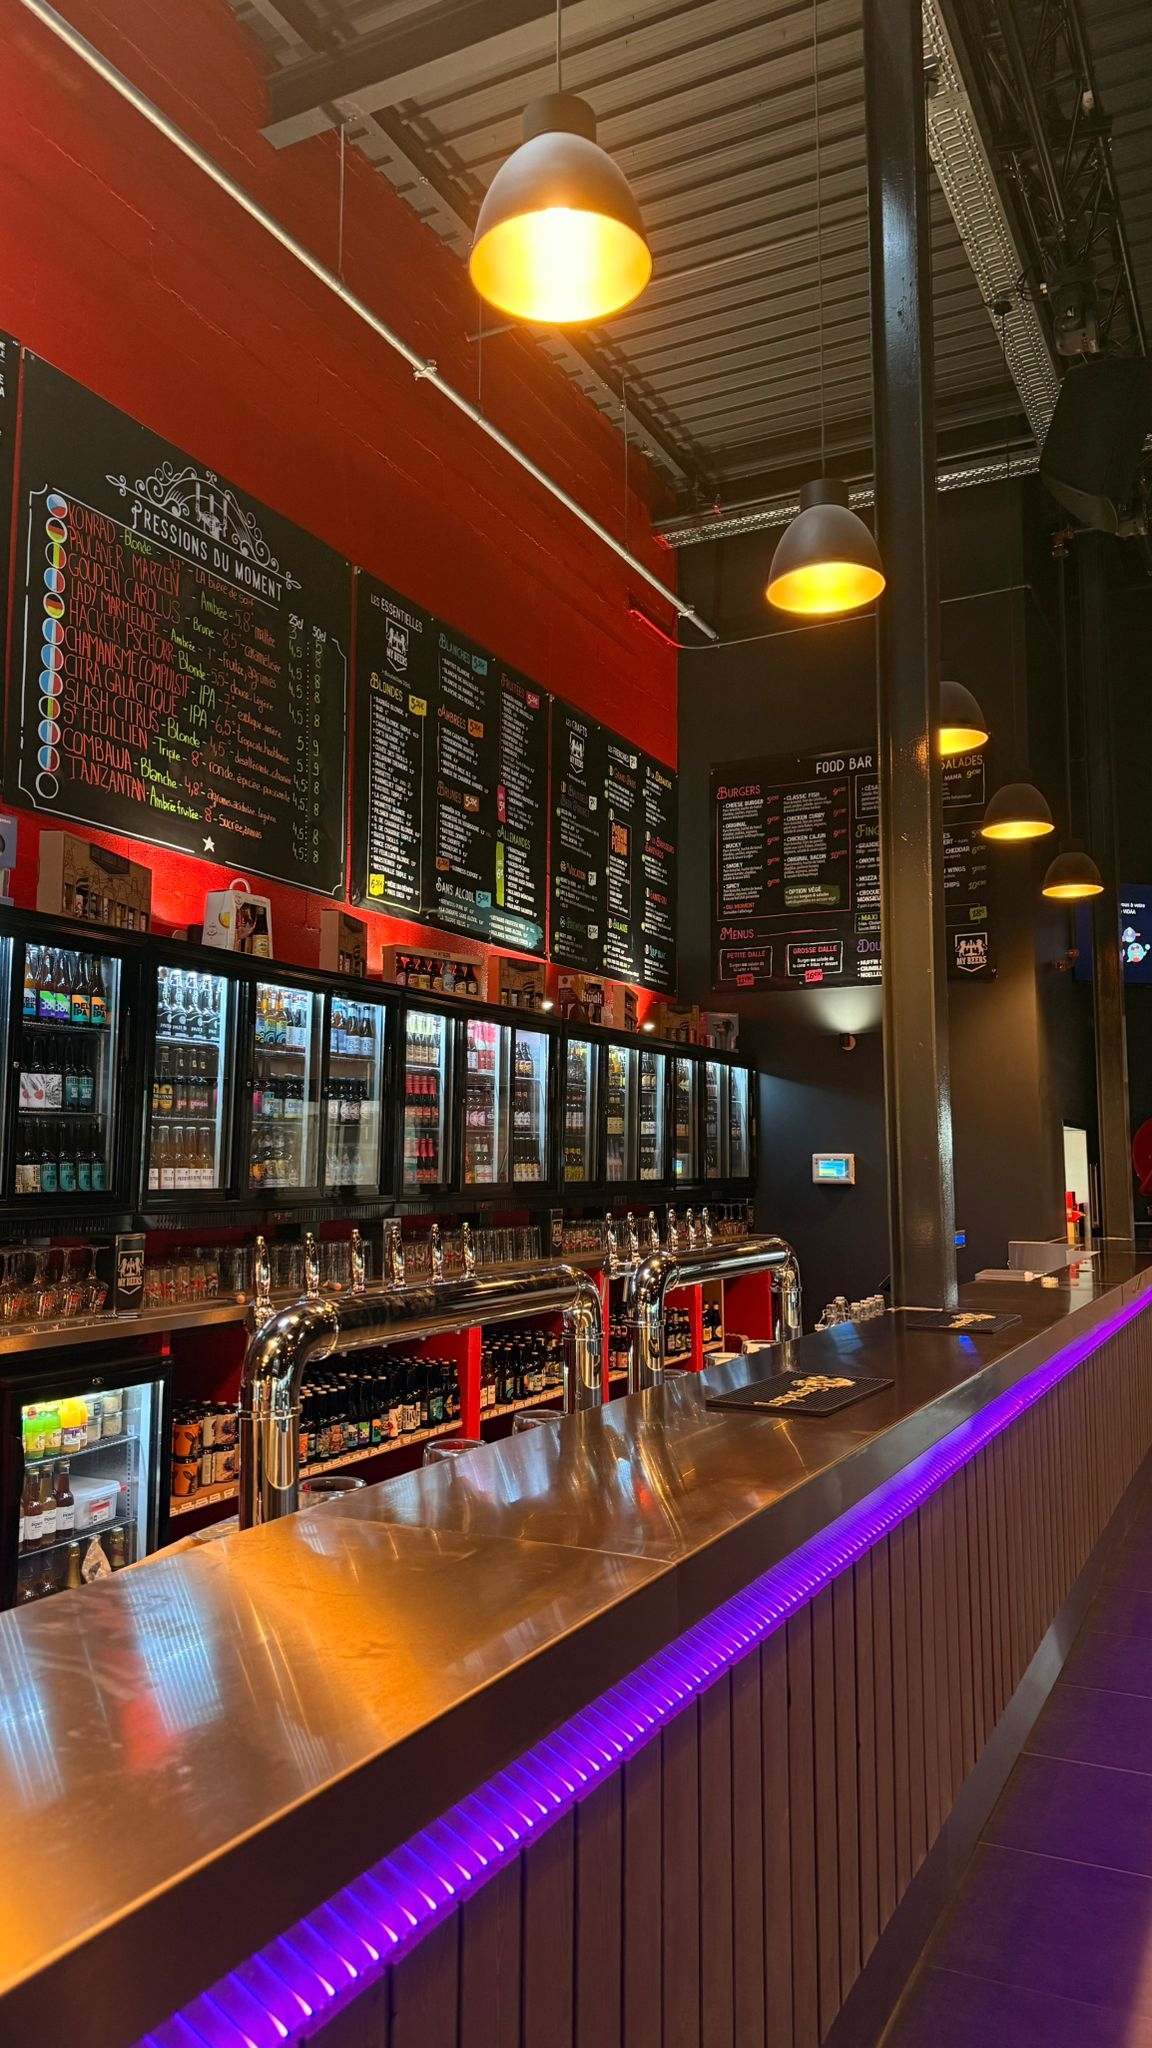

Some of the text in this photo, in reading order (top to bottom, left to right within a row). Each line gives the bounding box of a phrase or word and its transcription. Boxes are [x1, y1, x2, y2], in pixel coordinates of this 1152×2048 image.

[68, 502, 116, 543] KONRAD
[124, 529, 152, 555] Blonde
[131, 499, 282, 602] PRESSIONS DU MOMENT
[67, 525, 124, 573] PAULANER
[132, 553, 180, 597] MARZEN
[68, 553, 121, 596] GOUDEN
[125, 577, 181, 624] CAROLUS
[193, 616, 215, 639] Brune
[71, 577, 97, 606] LADY
[100, 591, 161, 635] MARMELADE
[370, 593, 423, 633] LES ESSENTIELLES
[69, 599, 121, 643] HACKER
[126, 622, 174, 664] PSCHORR
[178, 650, 206, 681] Blonde
[386, 647, 408, 667] MY BEERS
[64, 625, 139, 677] CHAMANISME
[199, 684, 216, 710] IPA
[314, 674, 321, 689] 8
[370, 671, 403, 702] BLONDES
[64, 653, 102, 687] CITRA
[104, 668, 179, 718] GALACTIQUE
[189, 704, 207, 729] IPA
[314, 691, 321, 704] 8
[64, 678, 109, 716] SLASH
[113, 695, 159, 733] CITRUS
[167, 716, 201, 748] Blonde
[314, 713, 320, 728] 8
[437, 703, 466, 730] AMBRÉES
[79, 706, 148, 751] FEUILLIEN
[154, 735, 181, 763] Triple
[571, 720, 588, 738] CRAFTS
[296, 735, 319, 757] 5 9
[62, 727, 132, 773] COMBAWA
[140, 756, 178, 789] Blanche
[816, 755, 872, 774] FOOD BAR
[296, 758, 320, 776] 5 9
[65, 753, 146, 802] TANZANTAN
[944, 773, 962, 781] MAMA
[313, 781, 320, 795] 8
[716, 784, 761, 800] BURGERS
[786, 791, 820, 801] CLASSIC FISH
[313, 803, 320, 816] 8
[725, 798, 764, 809] CHEESE BURGER
[786, 812, 825, 822] CHICKEN CURRY
[312, 829, 319, 846] 8
[786, 834, 808, 842] CHICKEN
[312, 850, 319, 864] 8
[945, 846, 970, 854] CHEDDAR
[786, 855, 809, 863] ORIGINAL
[858, 856, 875, 864] ONION
[435, 876, 475, 903] SANS ALCOOL
[788, 887, 807, 895] OPTION
[733, 902, 755, 910] MOMENT
[719, 927, 754, 941] MENUS
[747, 950, 765, 958] DALLE
[793, 944, 837, 955] GROSSE DALLE
[956, 955, 987, 966] MY BEERS
[118, 1275, 143, 1287] MY BEERS
